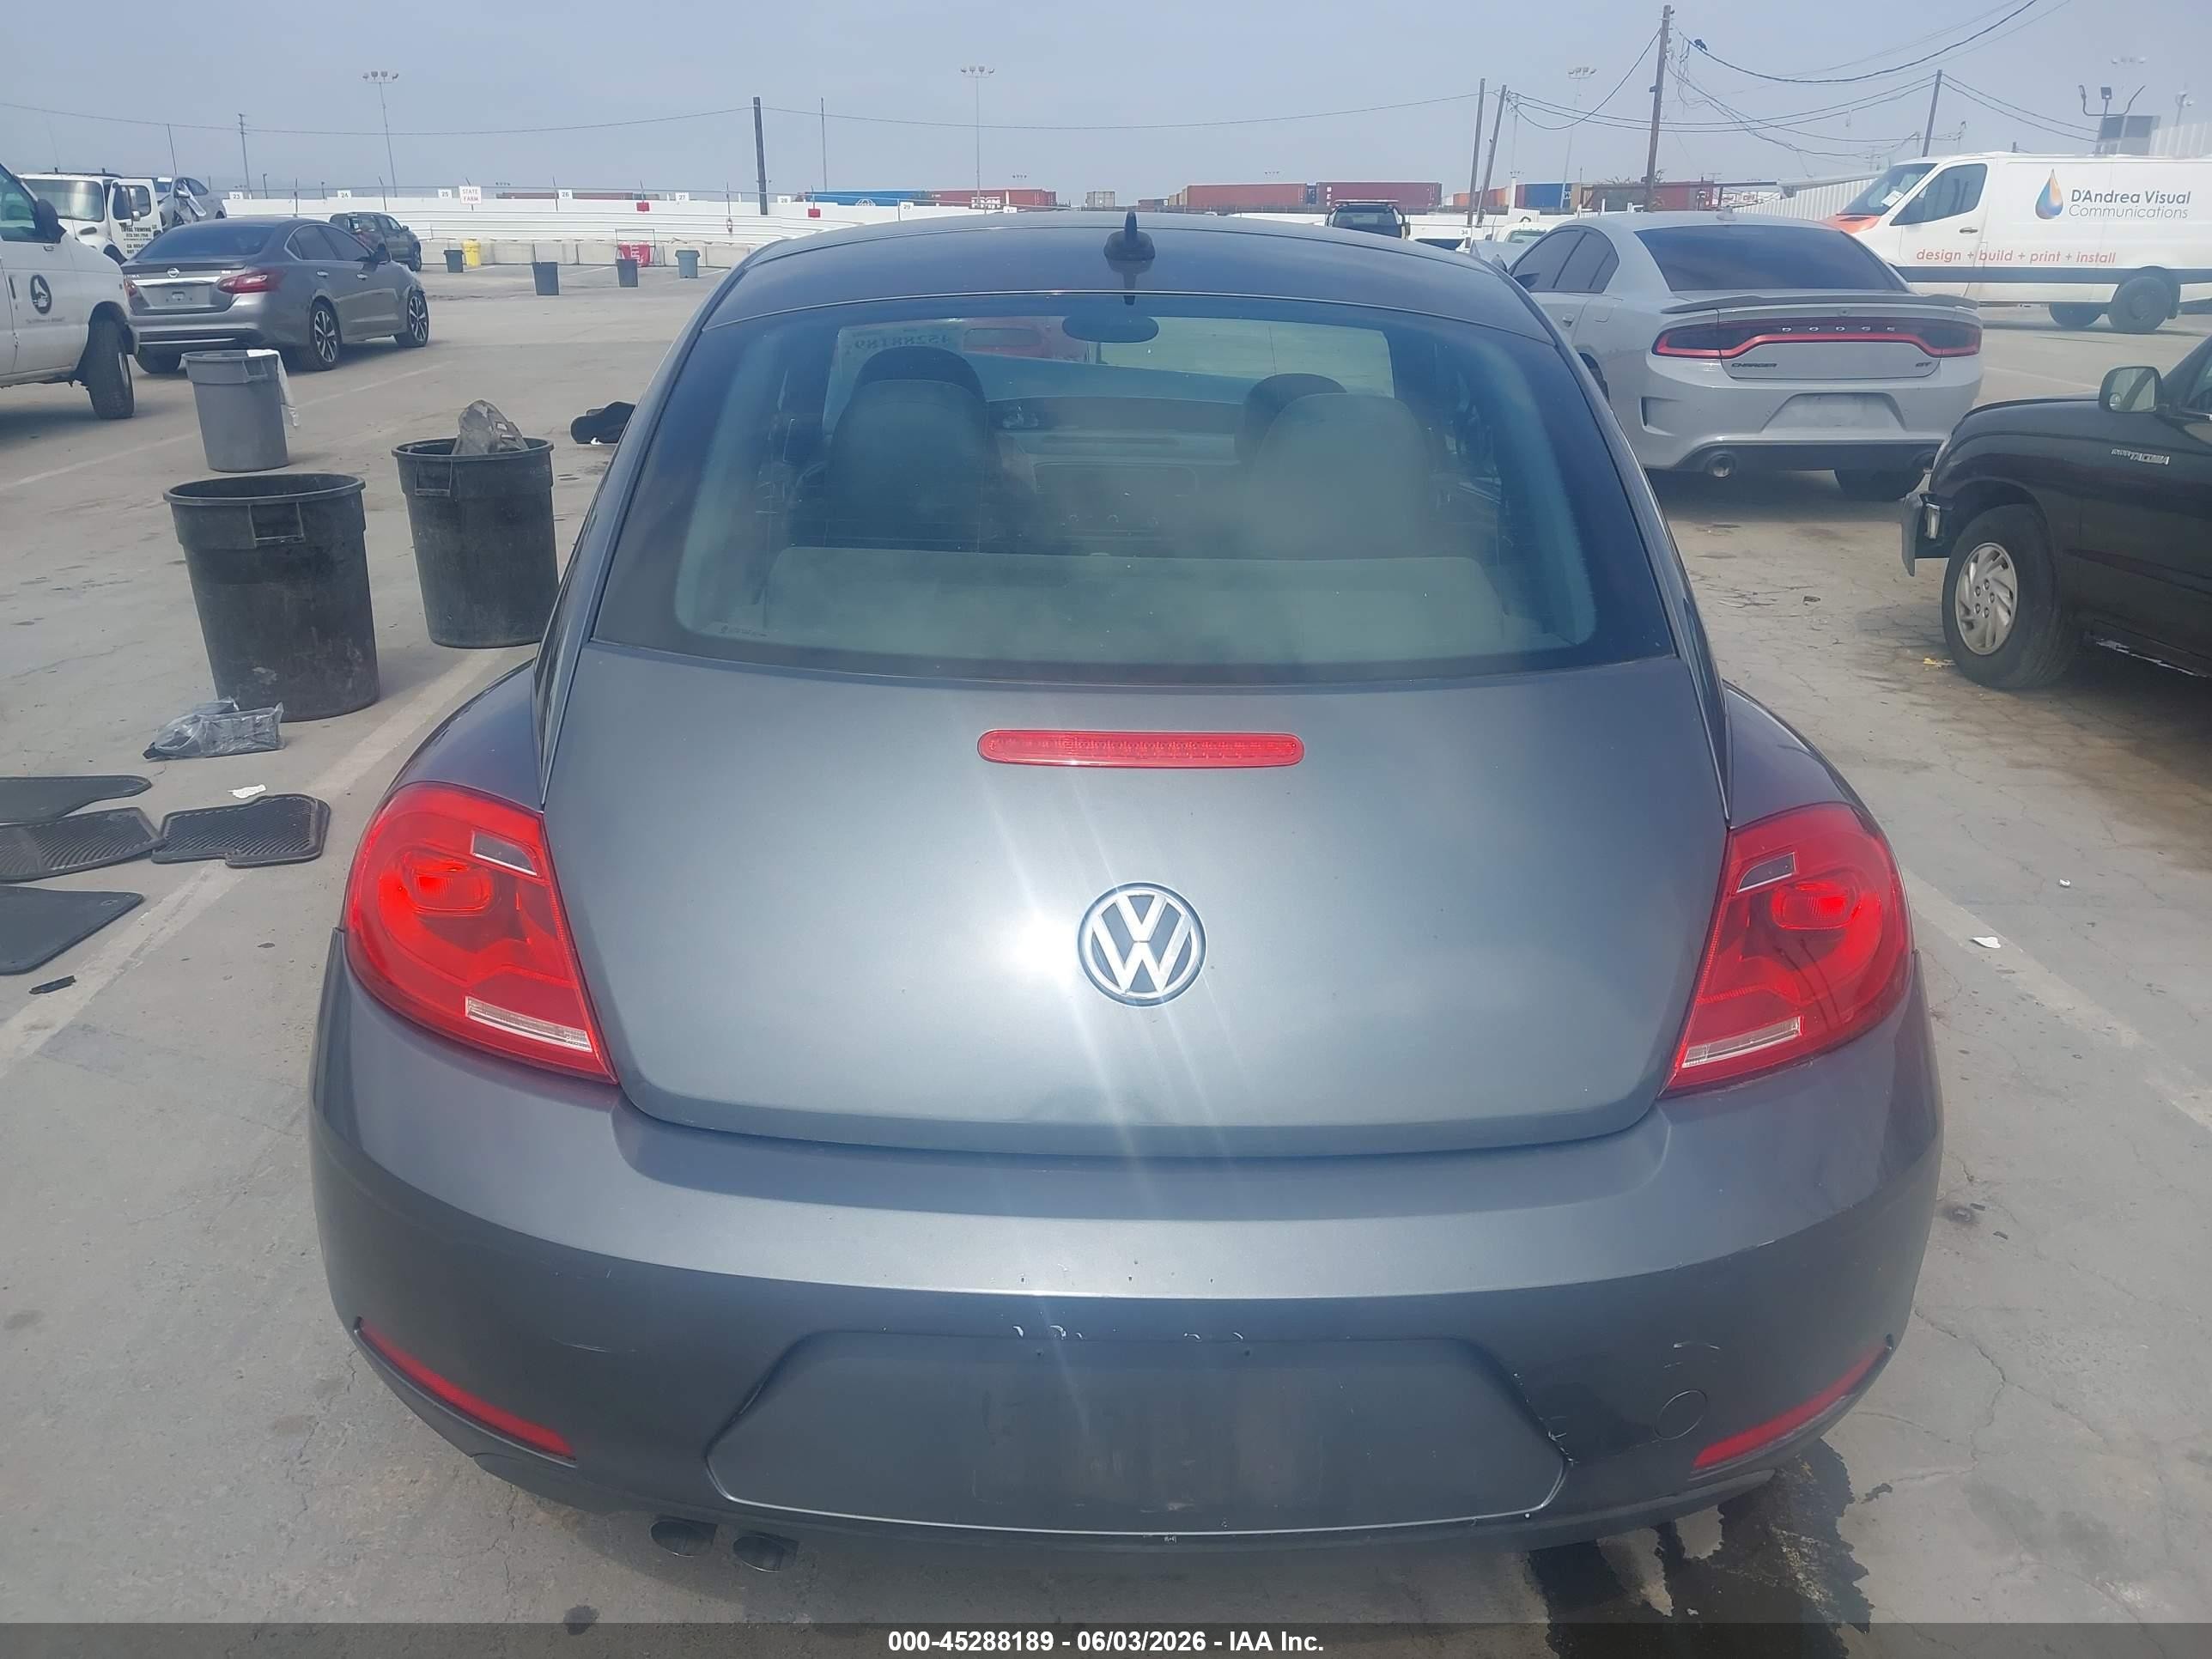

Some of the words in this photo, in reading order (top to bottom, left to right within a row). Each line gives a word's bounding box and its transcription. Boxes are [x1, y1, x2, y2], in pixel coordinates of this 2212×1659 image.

[2071, 189, 2141, 204] D'Andrea
[2145, 190, 2191, 204] Visual
[2069, 204, 2189, 219] Communications
[1916, 249, 1961, 263] design
[1978, 249, 2014, 261] build
[2029, 251, 2061, 264] print
[2076, 252, 2116, 264] install
